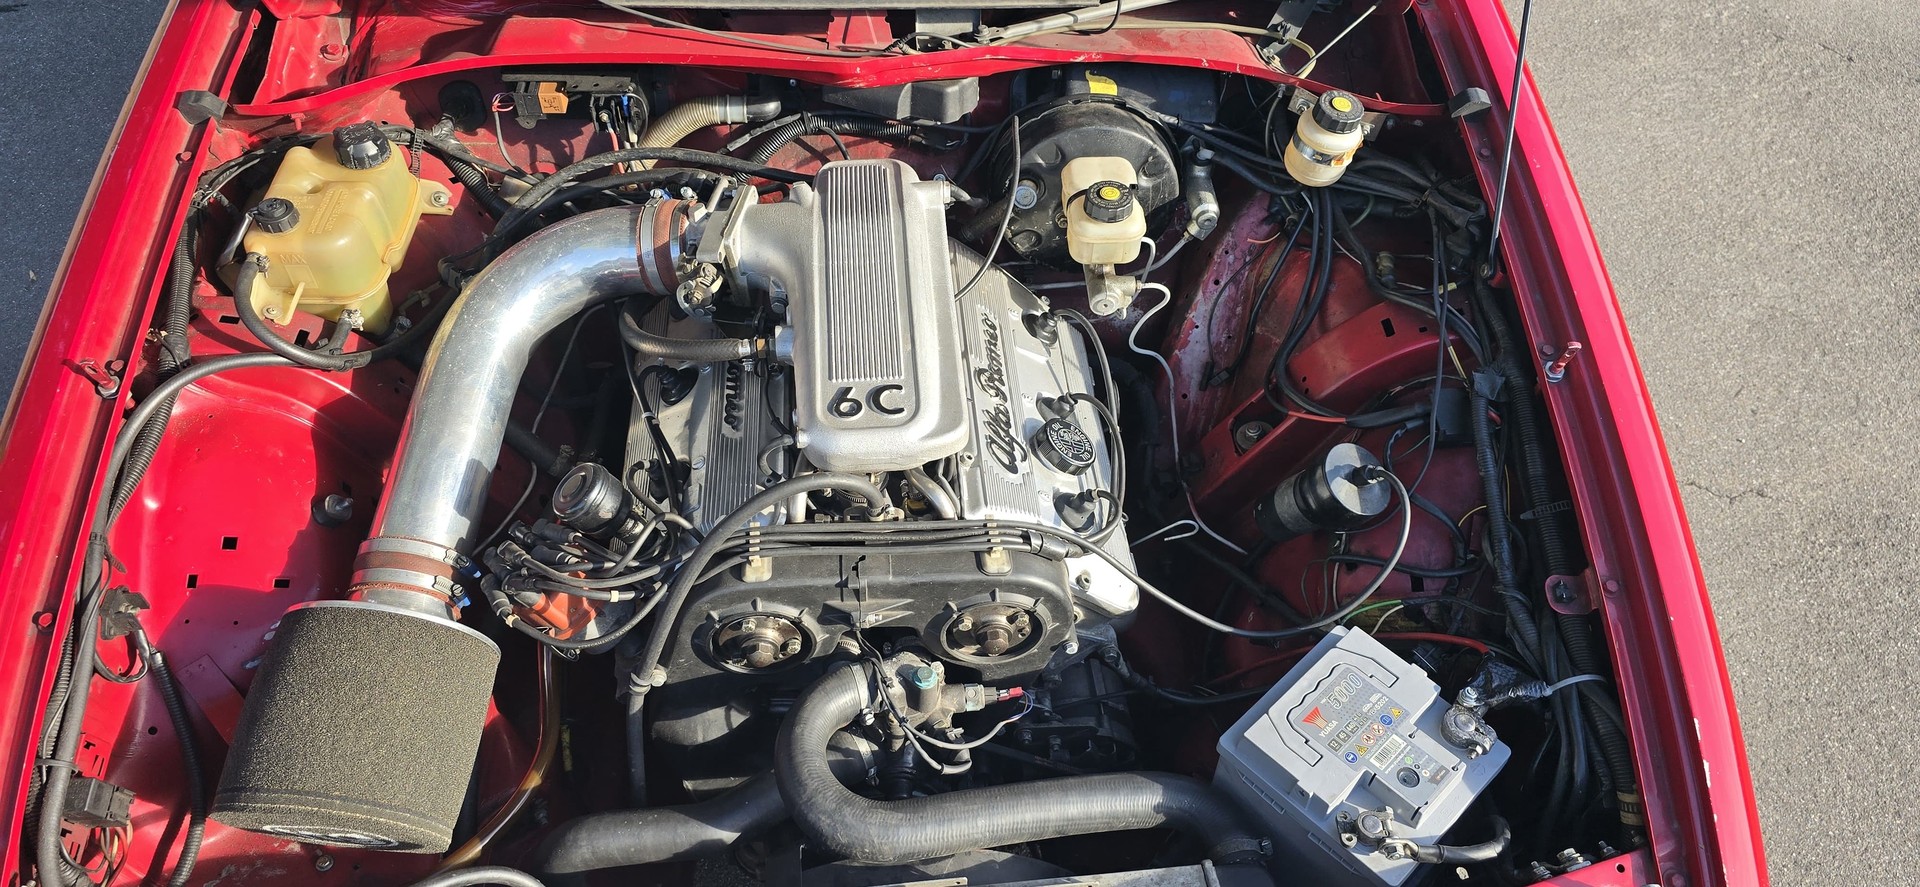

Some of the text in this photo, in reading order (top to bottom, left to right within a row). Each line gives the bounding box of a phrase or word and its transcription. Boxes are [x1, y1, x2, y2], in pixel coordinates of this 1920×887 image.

[723, 360, 742, 432] omeo
[829, 384, 906, 418] 6C
[973, 312, 1028, 475] Alfa Romeo
[1050, 422, 1073, 458] ENGINE OIL
[1070, 425, 1092, 460] ENGINE OIL
[615, 624, 632, 637] RATED
[1327, 672, 1363, 710] 5000
[1319, 720, 1338, 738] YUASA
